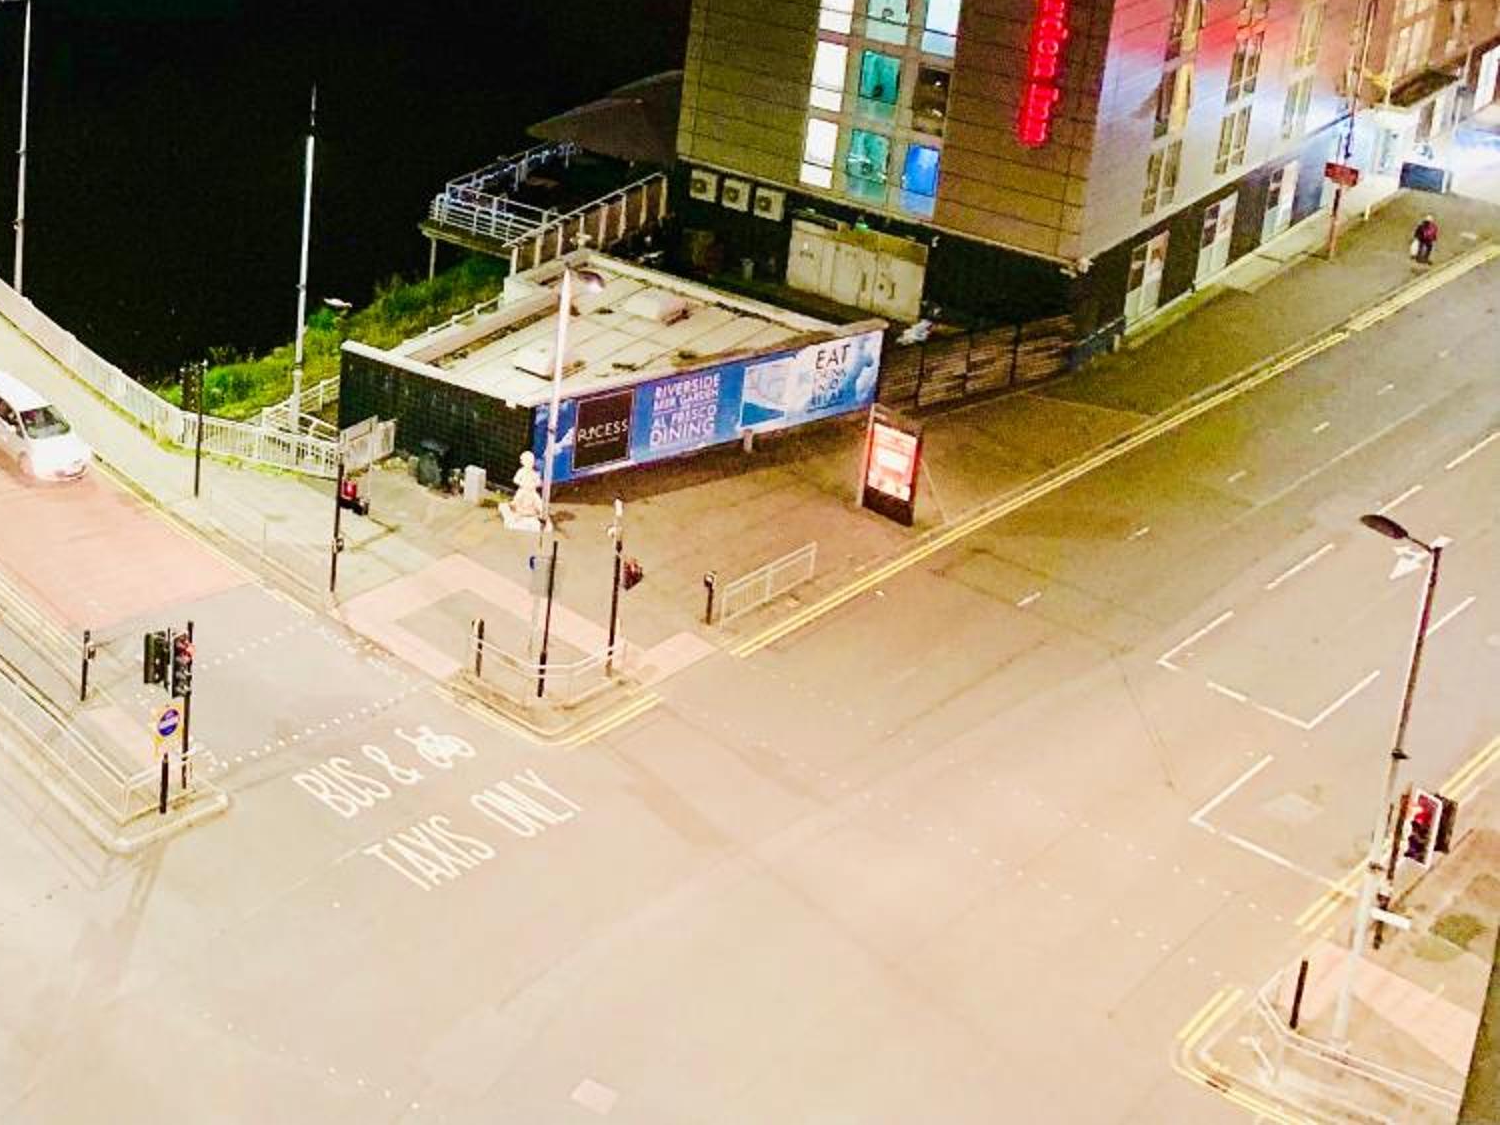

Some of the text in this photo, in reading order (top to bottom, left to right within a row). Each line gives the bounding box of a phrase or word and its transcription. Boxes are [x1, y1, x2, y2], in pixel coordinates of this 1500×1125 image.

[1021, 83, 1059, 146] Inn
[815, 343, 851, 370] EAT
[654, 373, 720, 397] RIVERSIDE
[671, 404, 718, 425] FRESCO
[649, 417, 715, 446] DINING
[293, 756, 392, 819] BUS
[363, 767, 581, 892] TAXIS ONLY
